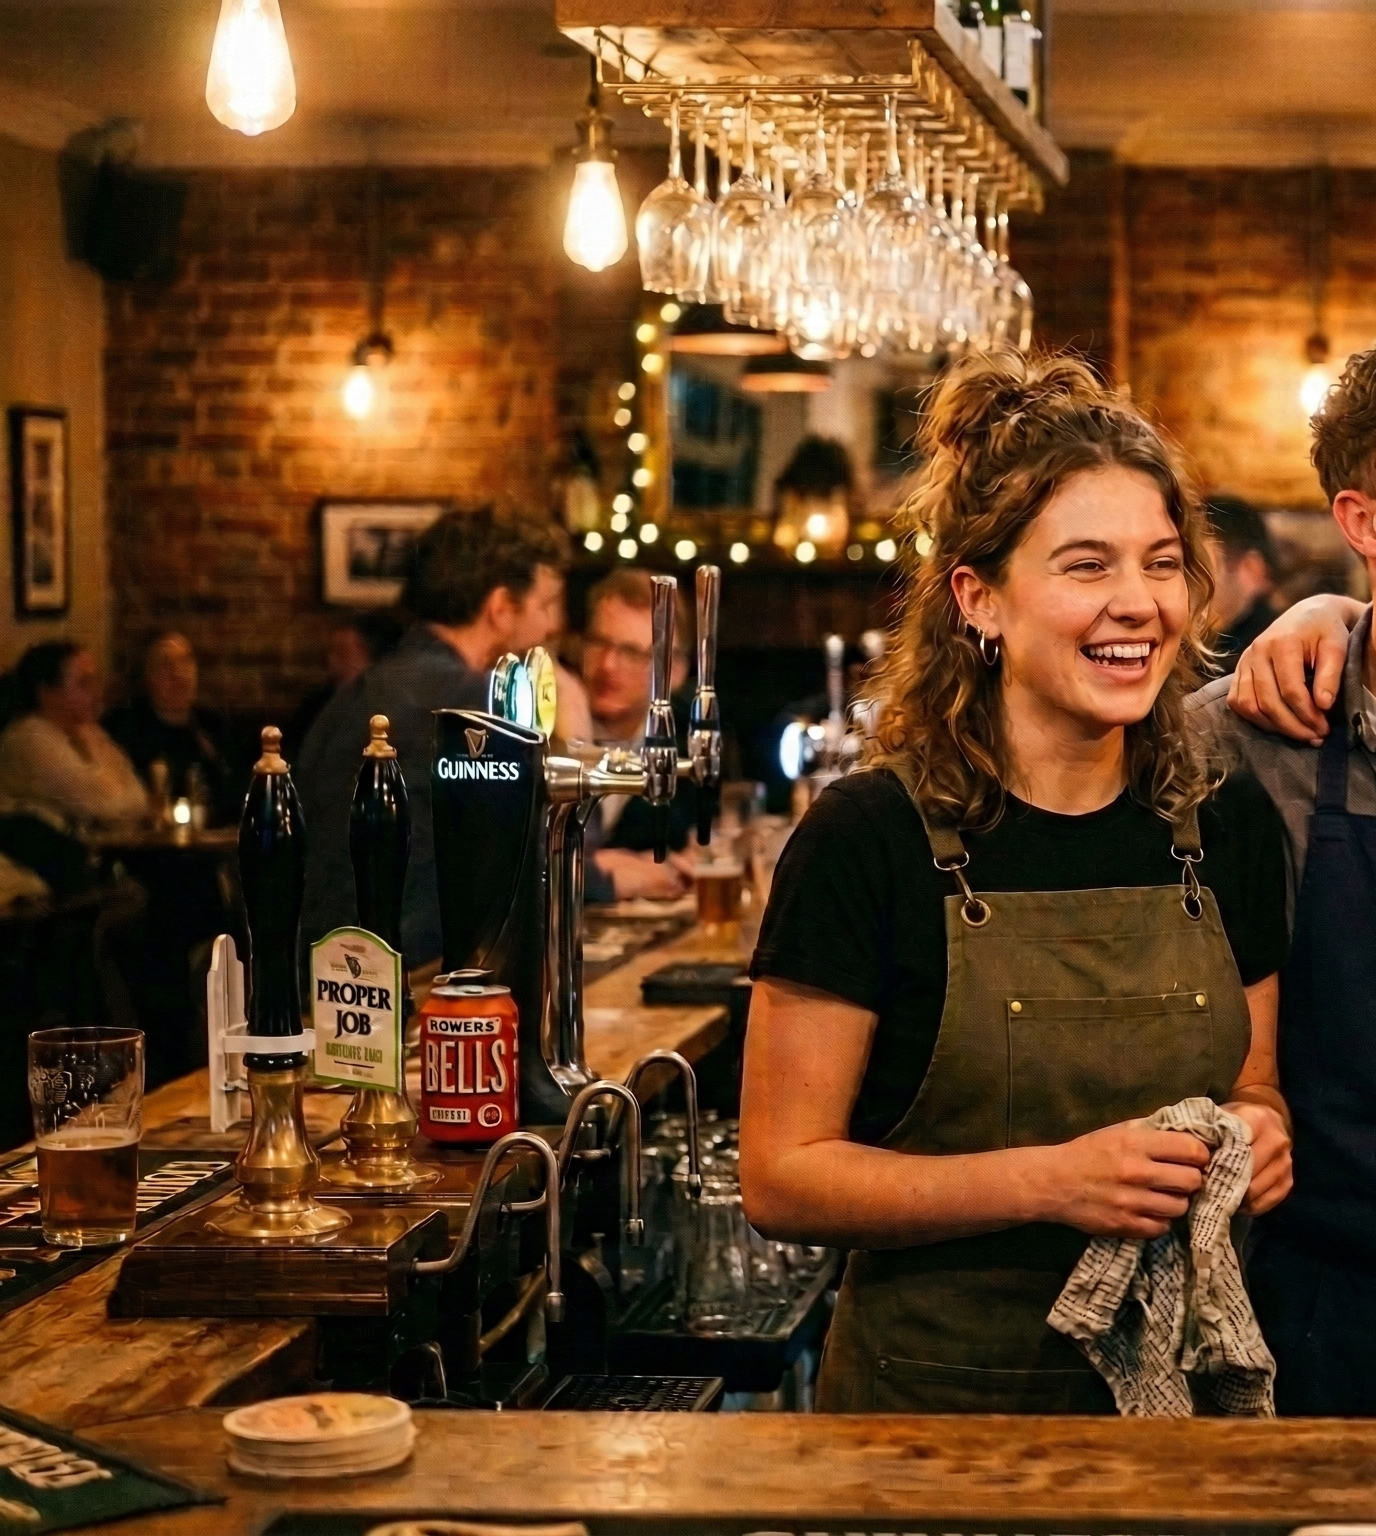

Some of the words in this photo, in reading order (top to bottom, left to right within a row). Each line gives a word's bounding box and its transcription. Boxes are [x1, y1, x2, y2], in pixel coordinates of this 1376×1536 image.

[437, 757, 520, 780] GUINNESS
[317, 979, 392, 1011] PROPER
[334, 1010, 371, 1039] JOB
[430, 1019, 495, 1033] ROWERS
[426, 1039, 507, 1094] BELLS
